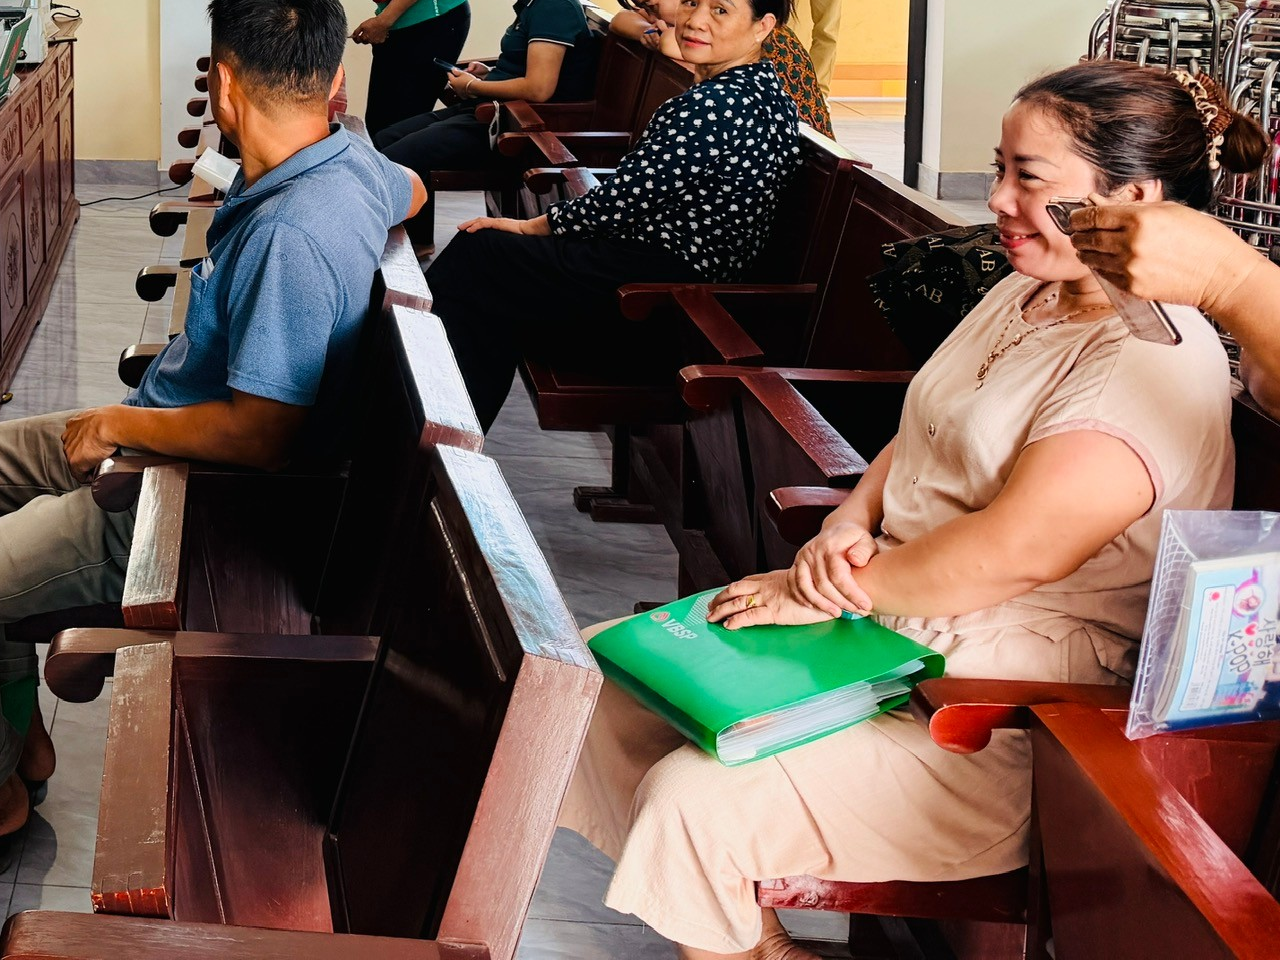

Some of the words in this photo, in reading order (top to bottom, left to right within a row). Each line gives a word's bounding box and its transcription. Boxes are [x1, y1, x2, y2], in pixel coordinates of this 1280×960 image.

[975, 248, 996, 272] AB
[915, 283, 943, 304] AB
[661, 618, 698, 639] VBSP
[1253, 618, 1276, 667] 사랑해
